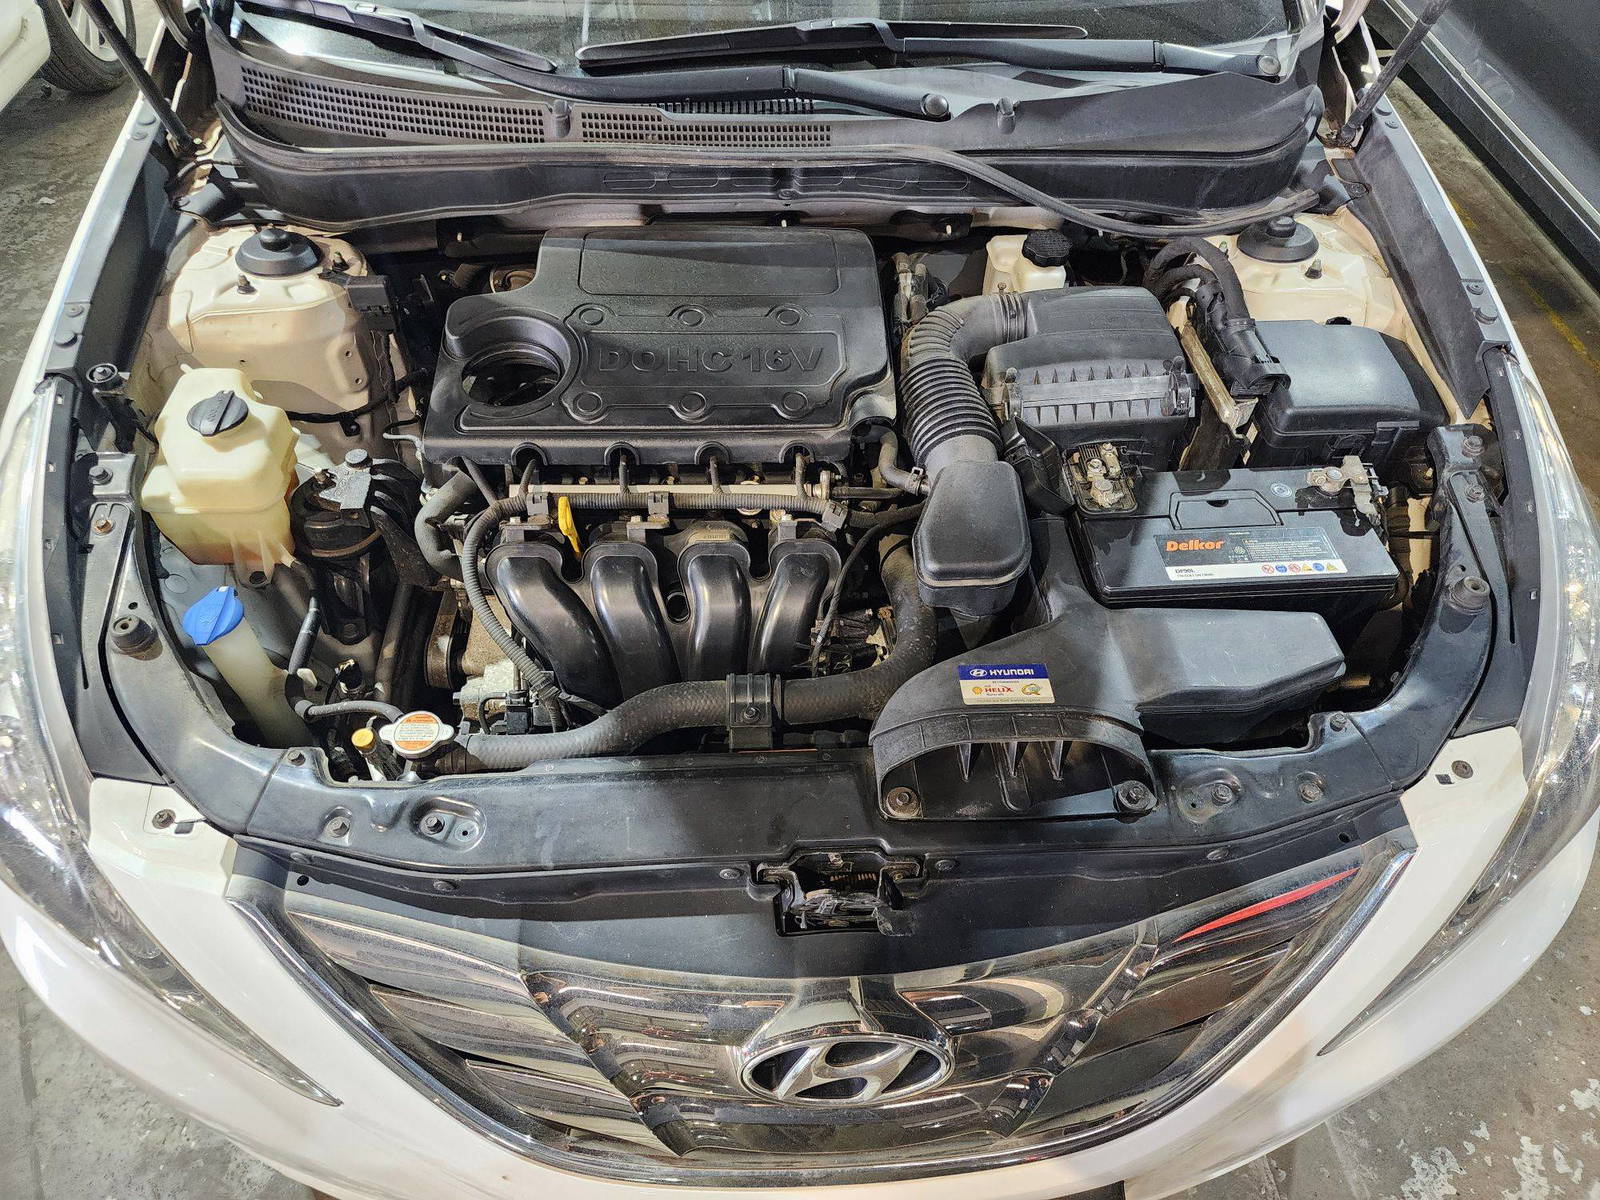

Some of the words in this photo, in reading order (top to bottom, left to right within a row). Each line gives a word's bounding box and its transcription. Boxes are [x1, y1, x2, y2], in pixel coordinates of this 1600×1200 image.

[599, 346, 734, 373] DOHC
[740, 346, 825, 373] 16V
[1166, 539, 1225, 551] Delkor
